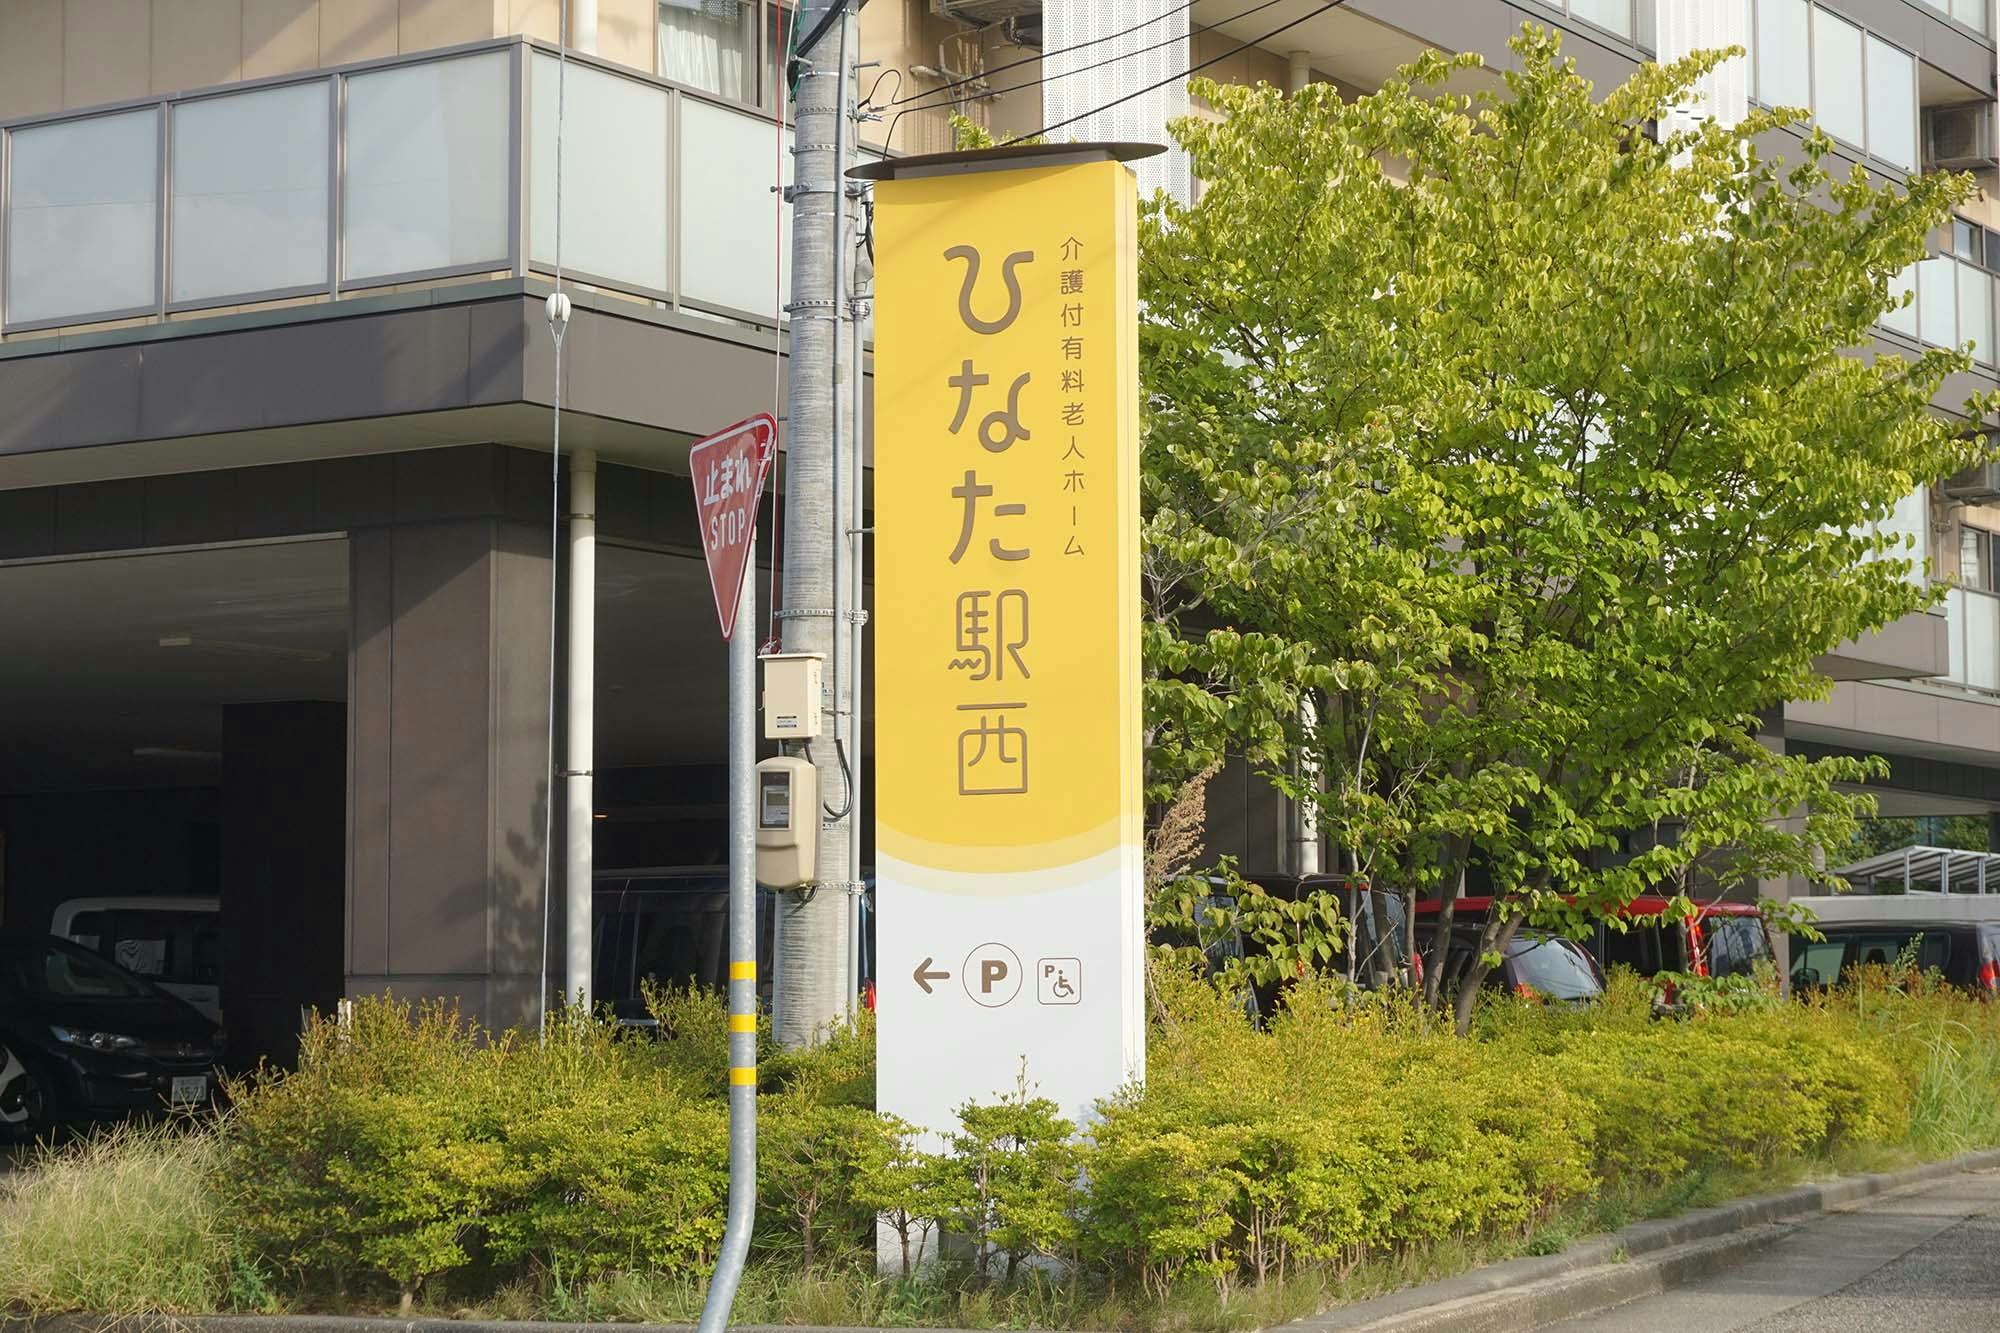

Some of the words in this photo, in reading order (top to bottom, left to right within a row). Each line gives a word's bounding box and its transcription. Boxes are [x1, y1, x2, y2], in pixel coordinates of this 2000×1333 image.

[1060, 236, 1085, 556] 介護付有料老人ホーム
[705, 450, 752, 506] 止まれ
[711, 508, 746, 550] STOP
[943, 244, 1034, 796] ひなた駅西
[982, 960, 1007, 993] P
[1045, 964, 1055, 978] P
